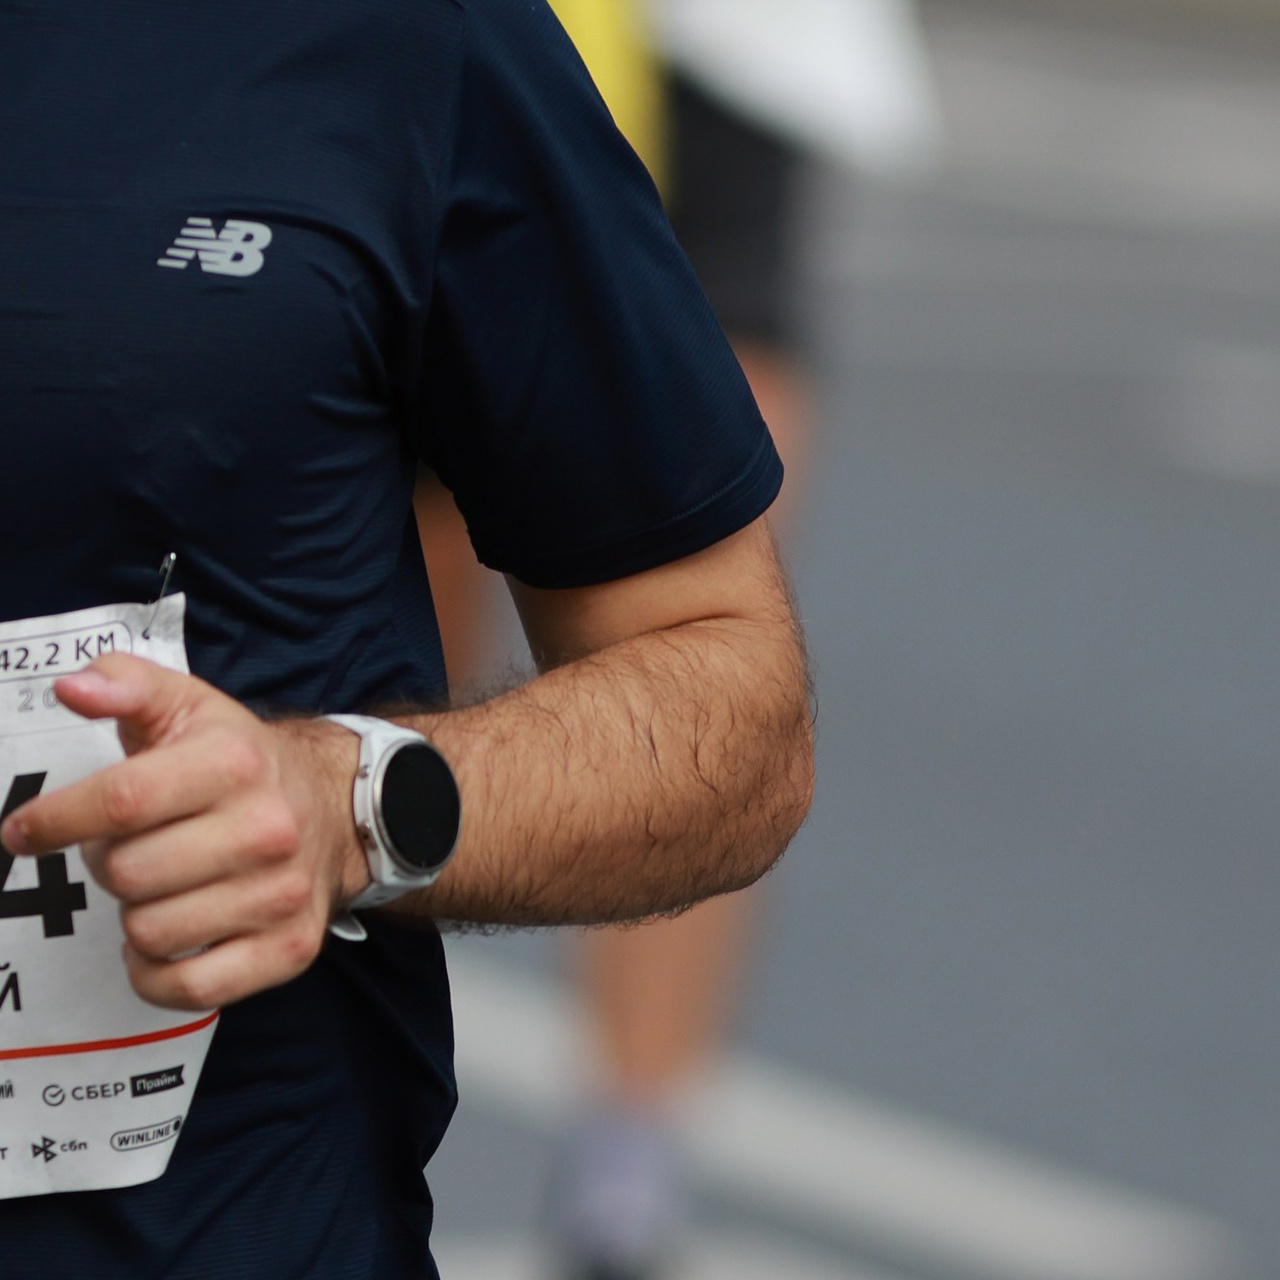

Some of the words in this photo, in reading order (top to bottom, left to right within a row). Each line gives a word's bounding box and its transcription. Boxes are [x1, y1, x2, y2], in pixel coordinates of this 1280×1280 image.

[75, 631, 115, 661] КМ
[71, 1082, 126, 1101] СБЕР
[135, 1073, 178, 1091] Прайм
[60, 1140, 88, 1153] сбп
[117, 1124, 171, 1147] WINLINE
